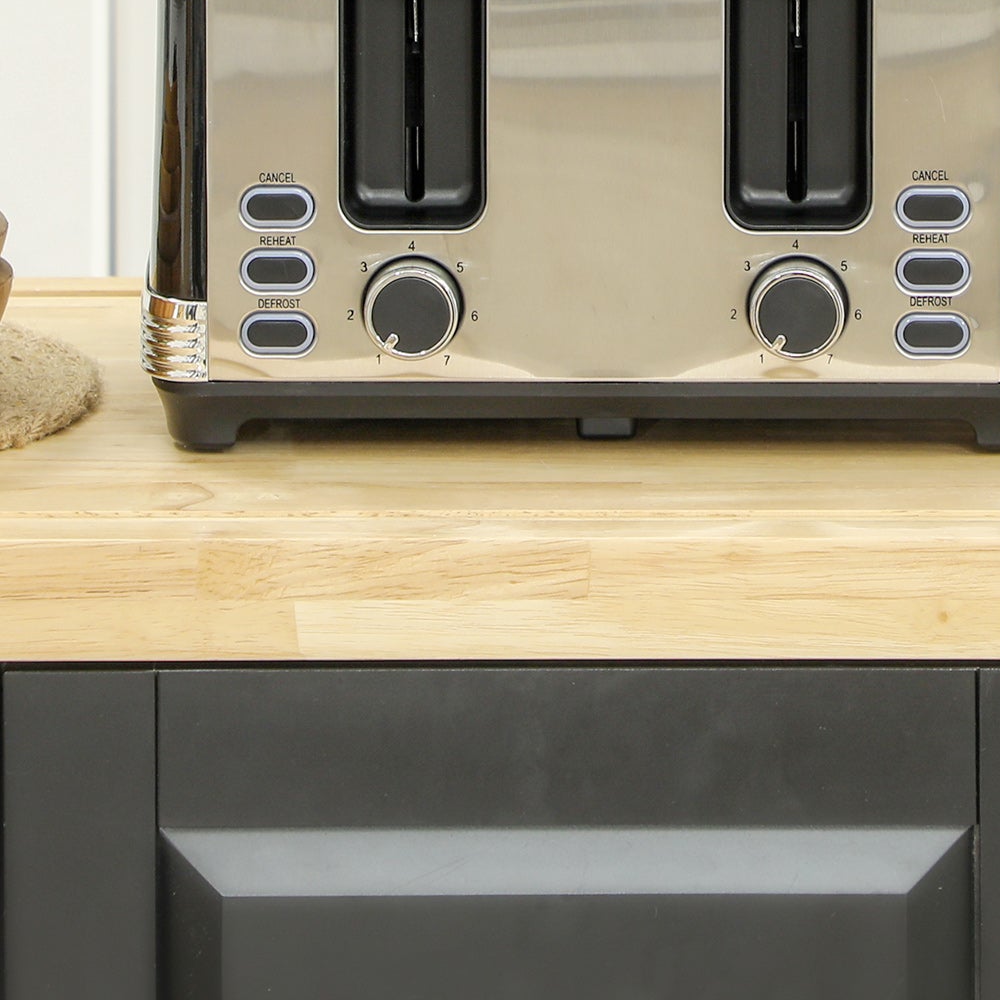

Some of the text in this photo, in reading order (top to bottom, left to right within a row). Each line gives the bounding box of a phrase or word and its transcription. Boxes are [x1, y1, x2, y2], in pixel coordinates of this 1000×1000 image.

[258, 172, 297, 184] CANCEL
[911, 169, 949, 182] CANCEL
[259, 235, 297, 247] REHEAT
[791, 239, 799, 250] 4
[912, 233, 950, 245] REHEAT
[407, 240, 416, 252] 4
[360, 261, 368, 273] 3
[456, 261, 464, 273] 5
[743, 260, 751, 272] 3
[840, 260, 848, 272] 5
[257, 298, 301, 310] DEFROST
[909, 295, 953, 307] DEFROST
[346, 309, 355, 321] 2
[470, 310, 479, 322] 6
[730, 308, 737, 320] 2
[854, 308, 862, 321] 6
[443, 354, 451, 366] 7
[826, 353, 834, 365] 7
